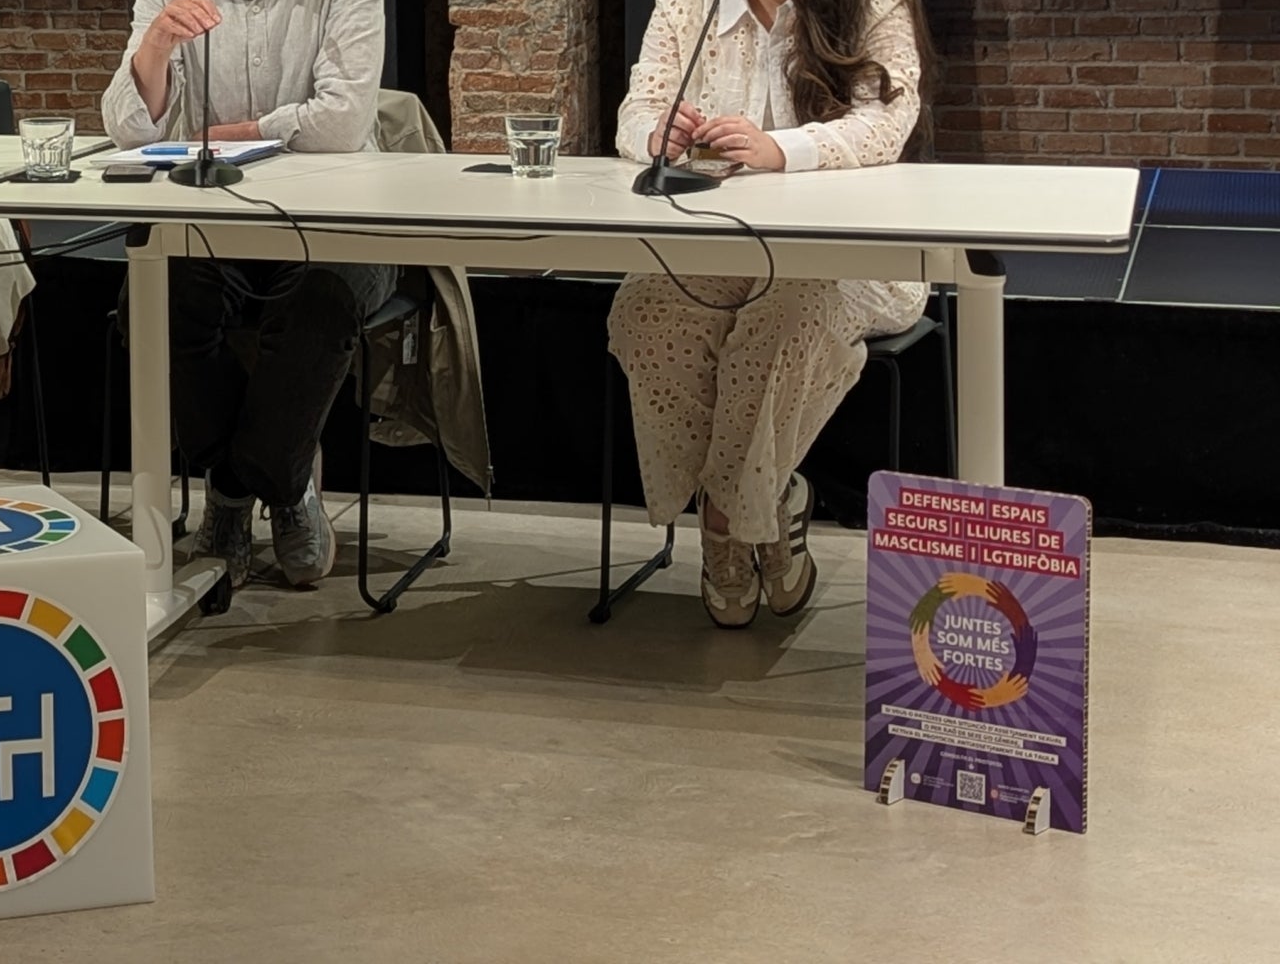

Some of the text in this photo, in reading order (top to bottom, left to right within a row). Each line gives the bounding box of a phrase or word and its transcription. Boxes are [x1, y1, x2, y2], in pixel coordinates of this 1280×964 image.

[902, 492, 1046, 524] DEFENSEM ESPAIS
[888, 513, 1060, 549] SEGURS I LLIURES DE
[875, 533, 1078, 575] MASCLISME I LGTBIFÒBIA
[944, 614, 1001, 635] JUNTES
[937, 631, 1009, 654] SOM MÉS
[943, 649, 1003, 671] FORTES
